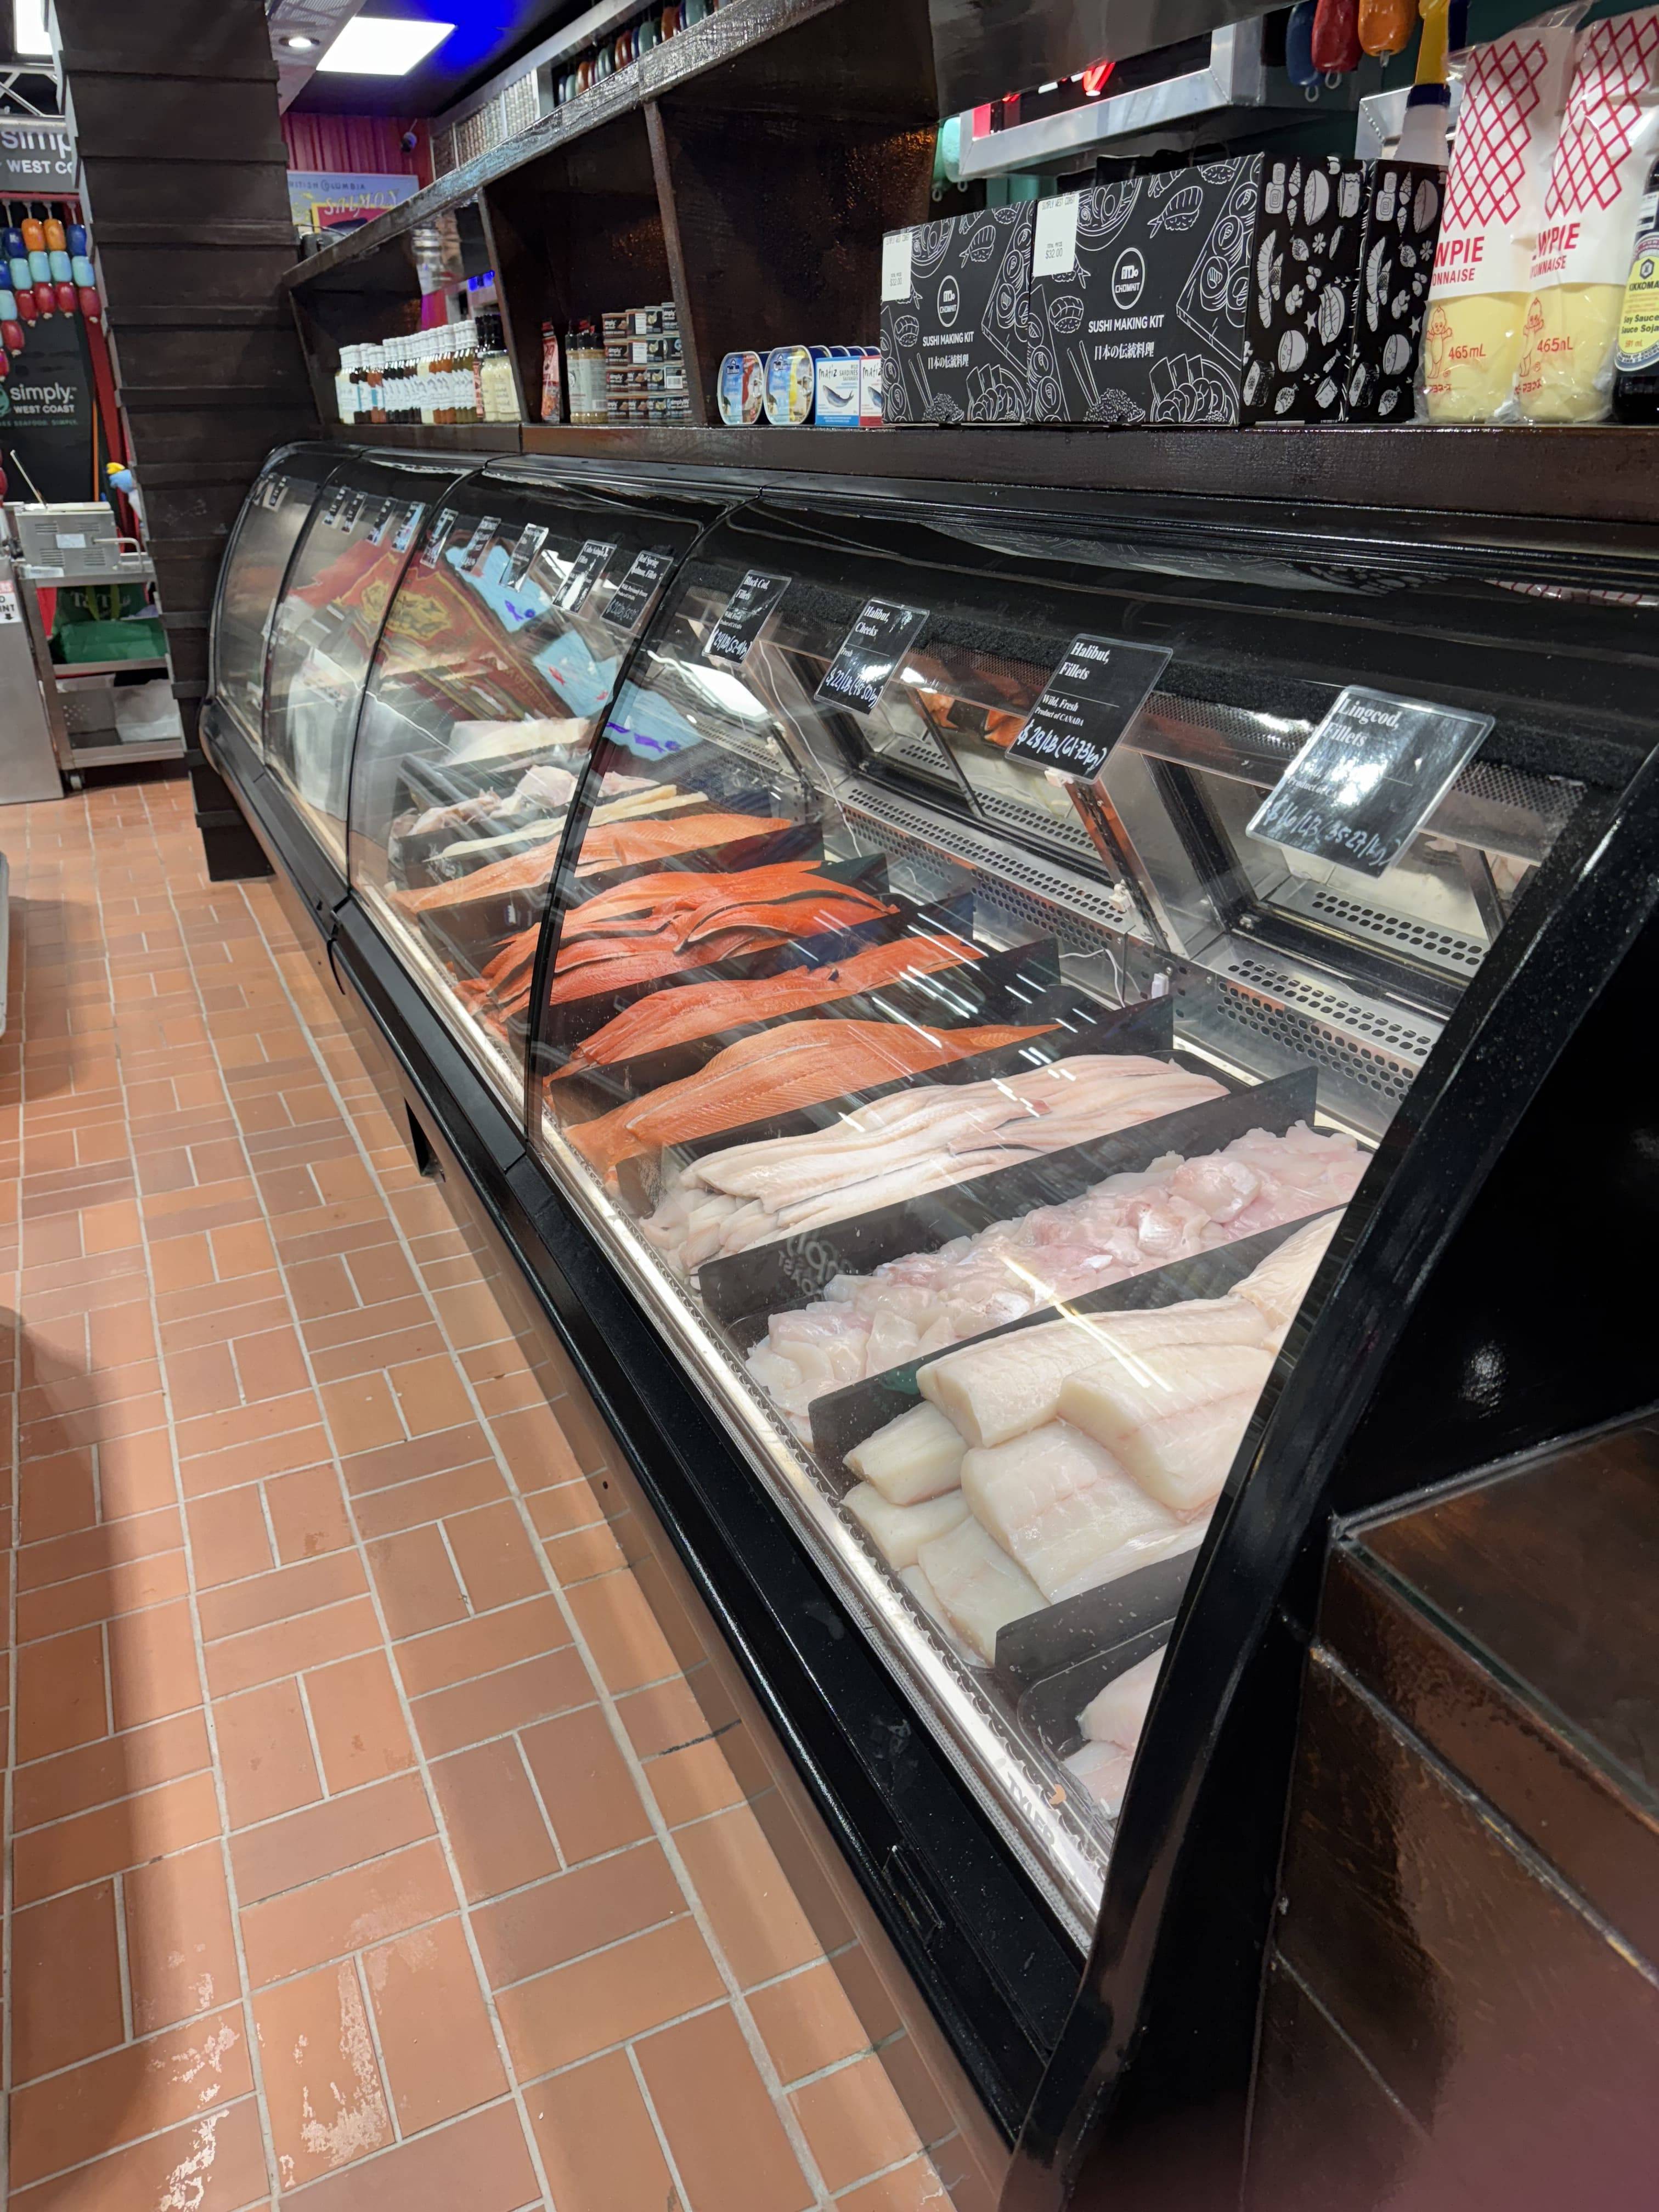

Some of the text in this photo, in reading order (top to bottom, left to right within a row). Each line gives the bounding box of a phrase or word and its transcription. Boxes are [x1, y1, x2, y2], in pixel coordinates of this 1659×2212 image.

[6, 159, 51, 174] WEST
[1042, 196, 1075, 210] SIMPLY WEST COAST
[1045, 247, 1063, 259] $32.00
[1115, 282, 1141, 294] CHOMKIT
[1088, 314, 1165, 334] SUSHI MAKING KIT
[923, 331, 975, 347] SUSHI MAKING KIT
[1094, 341, 1155, 360] 日本の伝統料理
[13, 404, 75, 414] WEST COAST
[743, 576, 759, 588] Black
[864, 606, 891, 624] Halibut,
[855, 622, 879, 637] Cheeks
[840, 647, 853, 657] Fresh
[1070, 642, 1110, 665] Halibut,
[1058, 662, 1091, 680] Fillets
[1042, 695, 1079, 712] Wild, Fresh
[1035, 707, 1055, 718] Product
[1059, 714, 1084, 726] CANADA
[1338, 698, 1403, 731] Lingcod,
[1321, 722, 1368, 747] Fillets
[1288, 776, 1316, 792] Product
